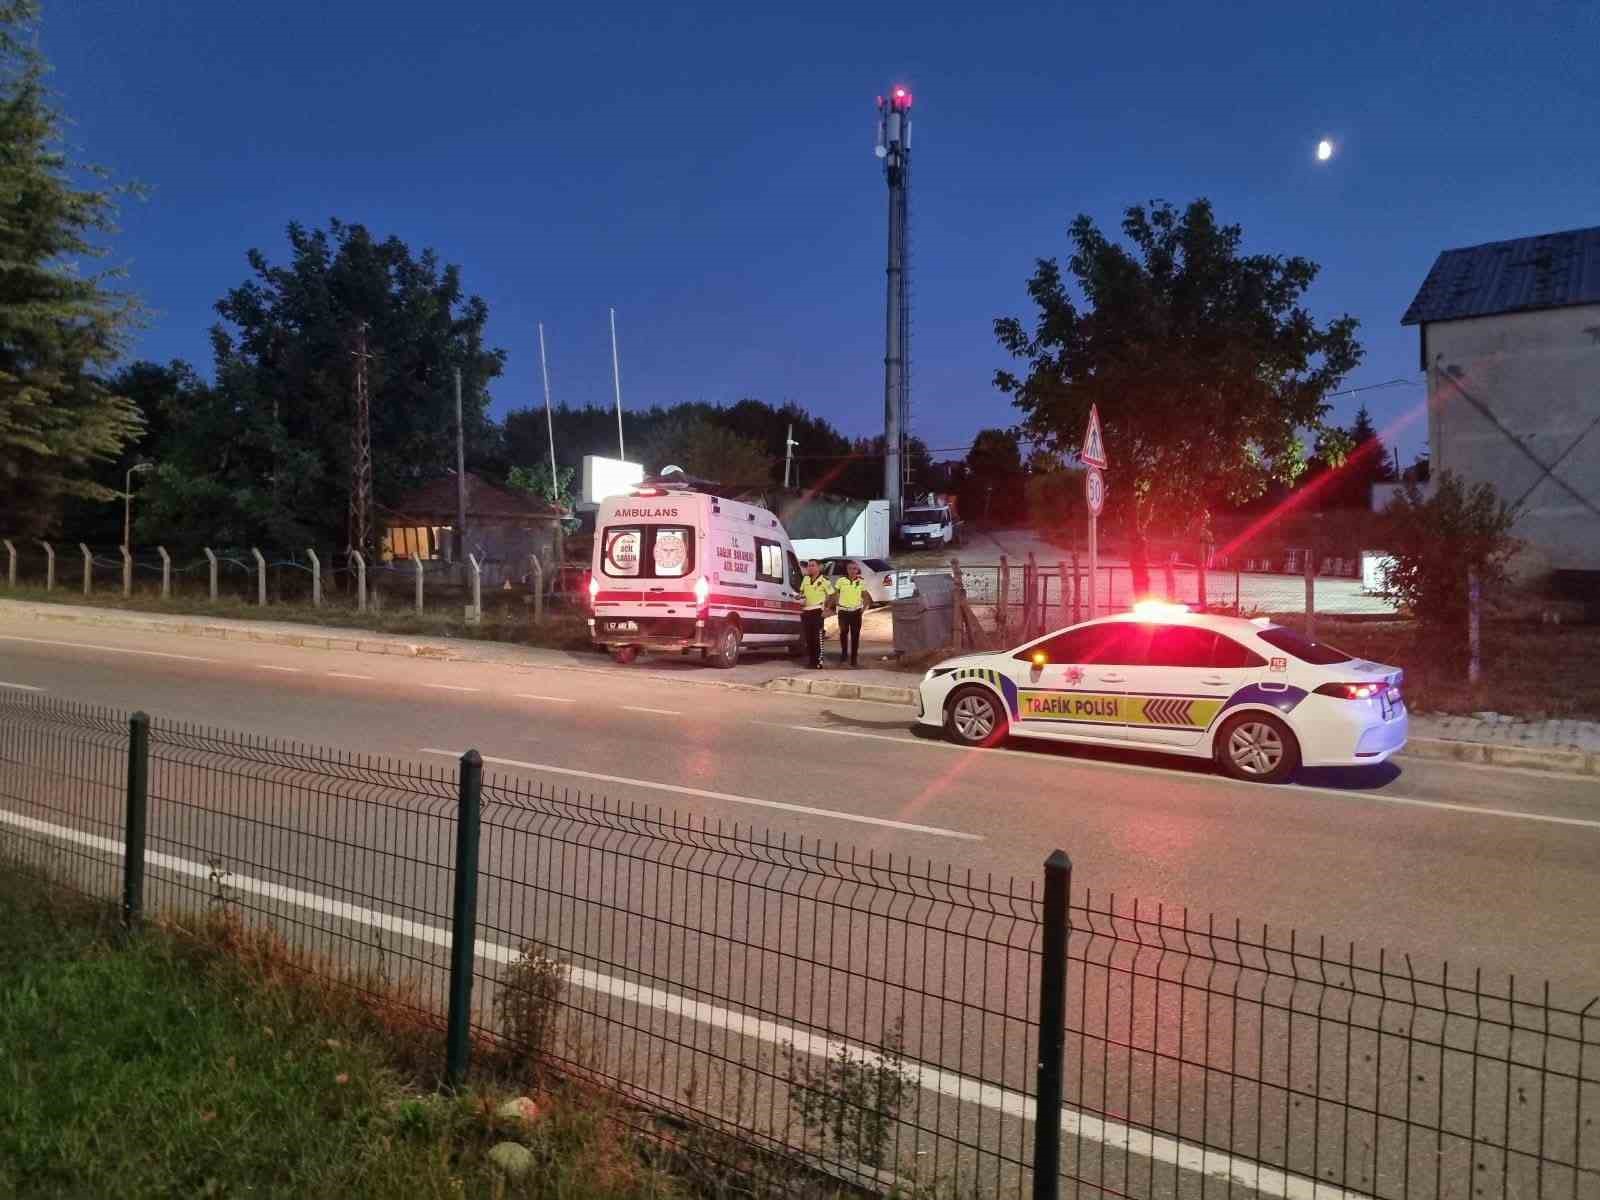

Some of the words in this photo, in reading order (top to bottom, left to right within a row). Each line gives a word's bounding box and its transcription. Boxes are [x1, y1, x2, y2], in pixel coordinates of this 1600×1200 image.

[614, 508, 679, 518] AMBULANS
[1025, 696, 1073, 714] TRAFİK
[1075, 698, 1119, 717] POLİSİ
